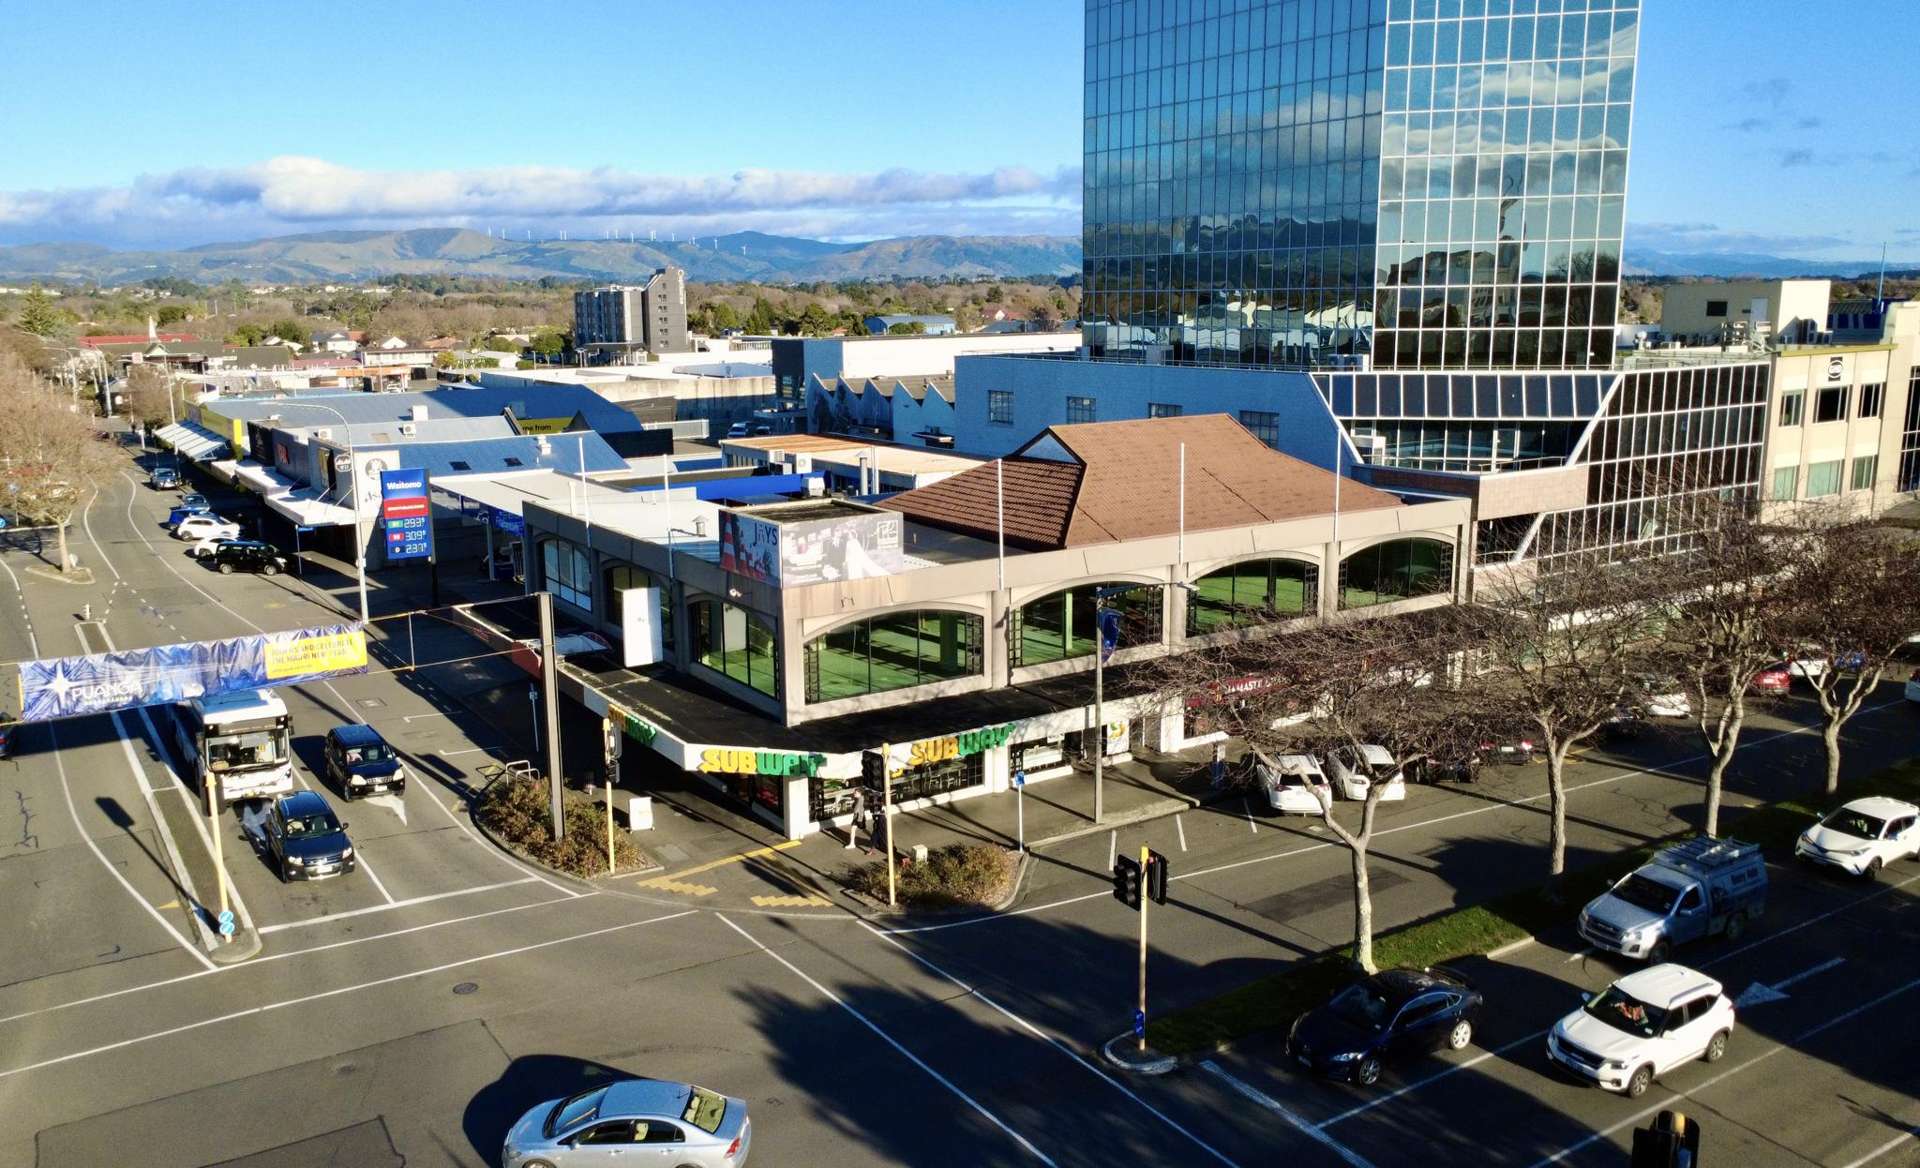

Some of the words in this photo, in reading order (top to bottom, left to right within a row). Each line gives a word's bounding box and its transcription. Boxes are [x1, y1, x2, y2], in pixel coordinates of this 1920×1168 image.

[386, 480, 423, 490] Waitomo
[906, 723, 1016, 766] SUBWAY
[698, 749, 826, 777] SUBWAY
